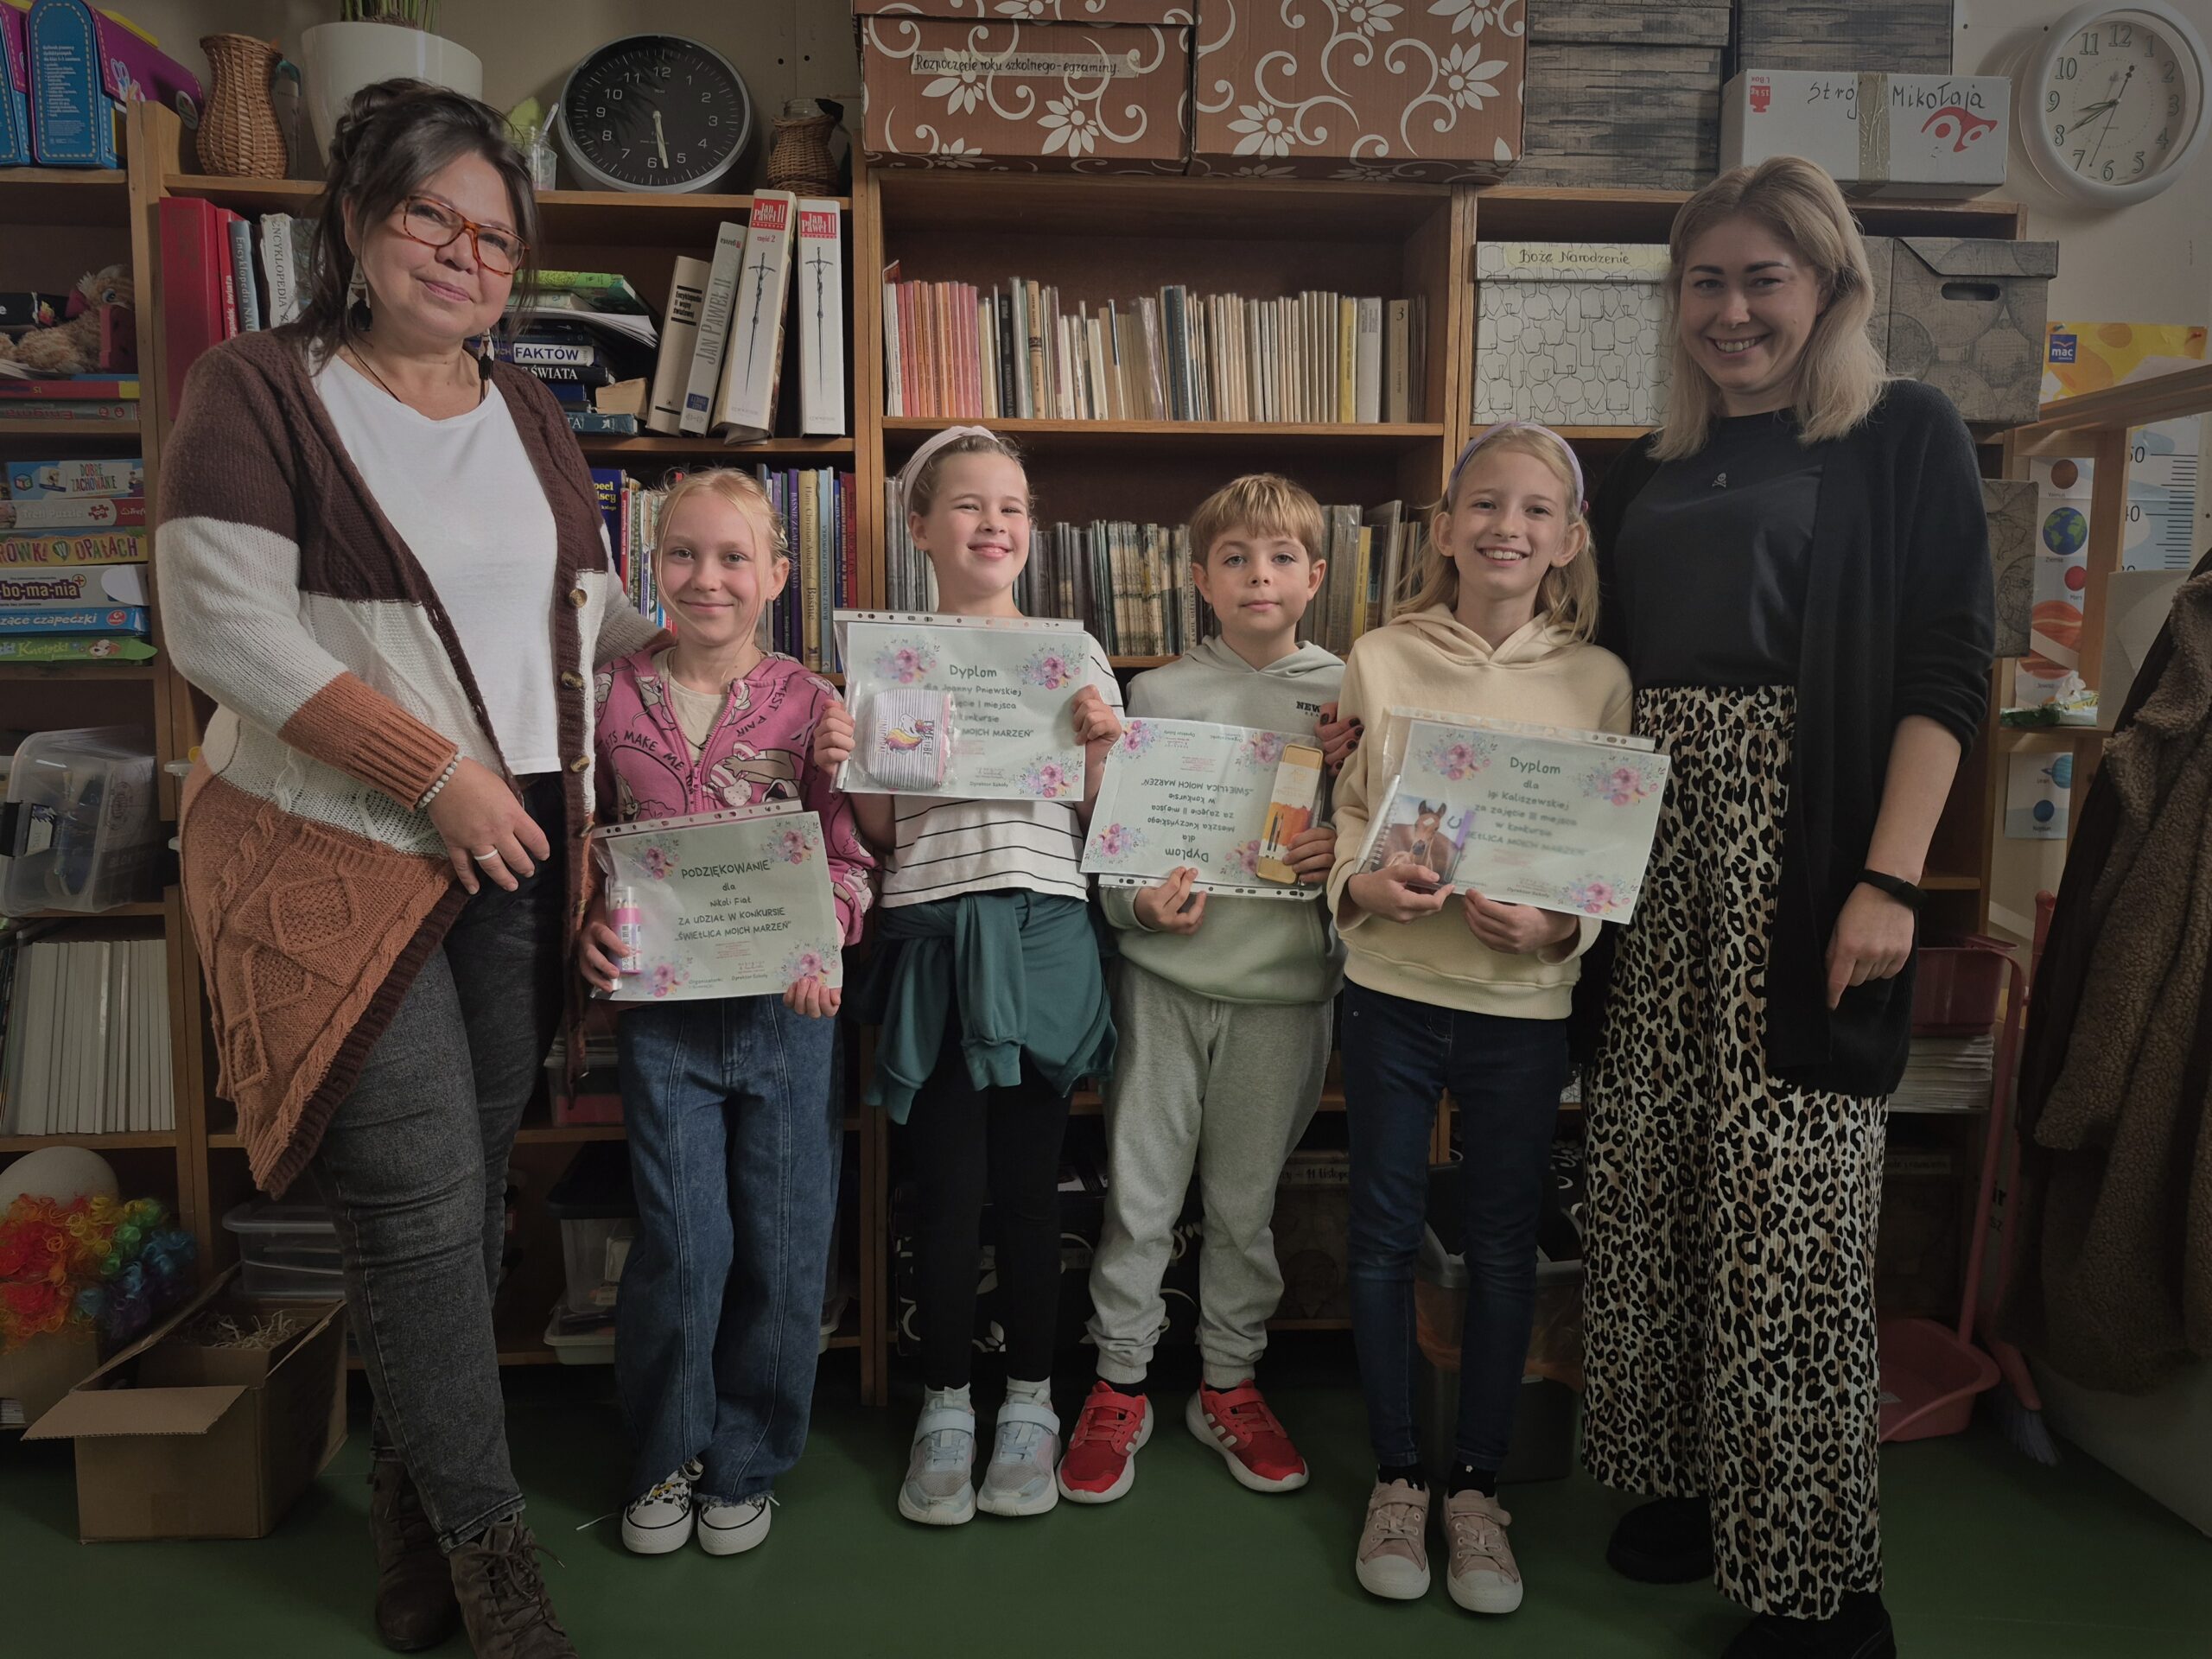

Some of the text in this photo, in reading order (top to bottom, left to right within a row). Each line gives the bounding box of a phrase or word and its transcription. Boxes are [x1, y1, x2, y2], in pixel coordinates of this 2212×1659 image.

[2108, 24, 2133, 48] 12
[2079, 32, 2099, 55] 11
[2144, 35, 2154, 58] 1
[914, 54, 977, 73] Rozpoczęcie
[980, 58, 1002, 71] roku
[2055, 56, 2077, 80] 10
[624, 72, 640, 84] 11
[653, 66, 671, 78] 12
[2161, 60, 2176, 83] 2
[686, 75, 692, 86] 1
[605, 88, 622, 100] 10
[701, 92, 711, 104] 2
[1808, 80, 1986, 124] Strój Mikołaja
[2045, 90, 2060, 112] 9
[2168, 94, 2180, 117] 3
[596, 106, 606, 118] 9
[709, 116, 718, 127] 3
[602, 130, 612, 141] 8
[2054, 124, 2065, 147] 8
[2156, 127, 2169, 149] 4
[697, 138, 708, 149] 4
[621, 149, 631, 159] 7
[677, 153, 686, 164] 5
[2072, 149, 2086, 172] 7
[648, 157, 658, 168] 6
[2132, 150, 2145, 174] 5
[2102, 159, 2115, 181] 6
[1558, 251, 1630, 264] Narodzenie
[235, 237, 251, 305] Encyklopedia
[515, 346, 579, 360] FAKTÓW
[696, 338, 719, 364] JAN
[2051, 347, 2073, 357] mac
[531, 365, 578, 380] ŚWIATA
[79, 463, 104, 476] DOBRE
[71, 476, 118, 492] ZACHOWANIE
[49, 508, 83, 519] Puzzle
[74, 537, 138, 561] OPAŁACH
[806, 544, 815, 580] Andersen
[807, 588, 817, 620] Baśnie
[34, 613, 98, 626] czapeczki
[950, 664, 997, 680] Dyplom
[976, 685, 1022, 697] Pniewskiej
[983, 702, 1017, 710] miejsca
[736, 715, 767, 738] PAIR
[962, 728, 989, 737] MOICH
[624, 730, 685, 772] MAKE ME
[1510, 757, 1560, 774] Dyplom
[1178, 781, 1204, 790] MOICH
[1523, 779, 1539, 790] dla
[1168, 793, 1205, 804] konkursie
[1502, 791, 1570, 811] Kaliszewskiej
[1151, 804, 1180, 813] miejsca
[1190, 809, 1220, 818] zajęcie
[1491, 806, 1525, 818] zajęcie
[1147, 817, 1199, 830] Kuczyńskiego
[1182, 834, 1195, 842] dla
[1165, 849, 1209, 862] Dyplom
[722, 882, 736, 891] dla
[709, 899, 732, 907] Nikoli
[678, 907, 785, 925] ZA UDZIAŁ W KONKURSIE
[725, 926, 750, 937] MOICH
